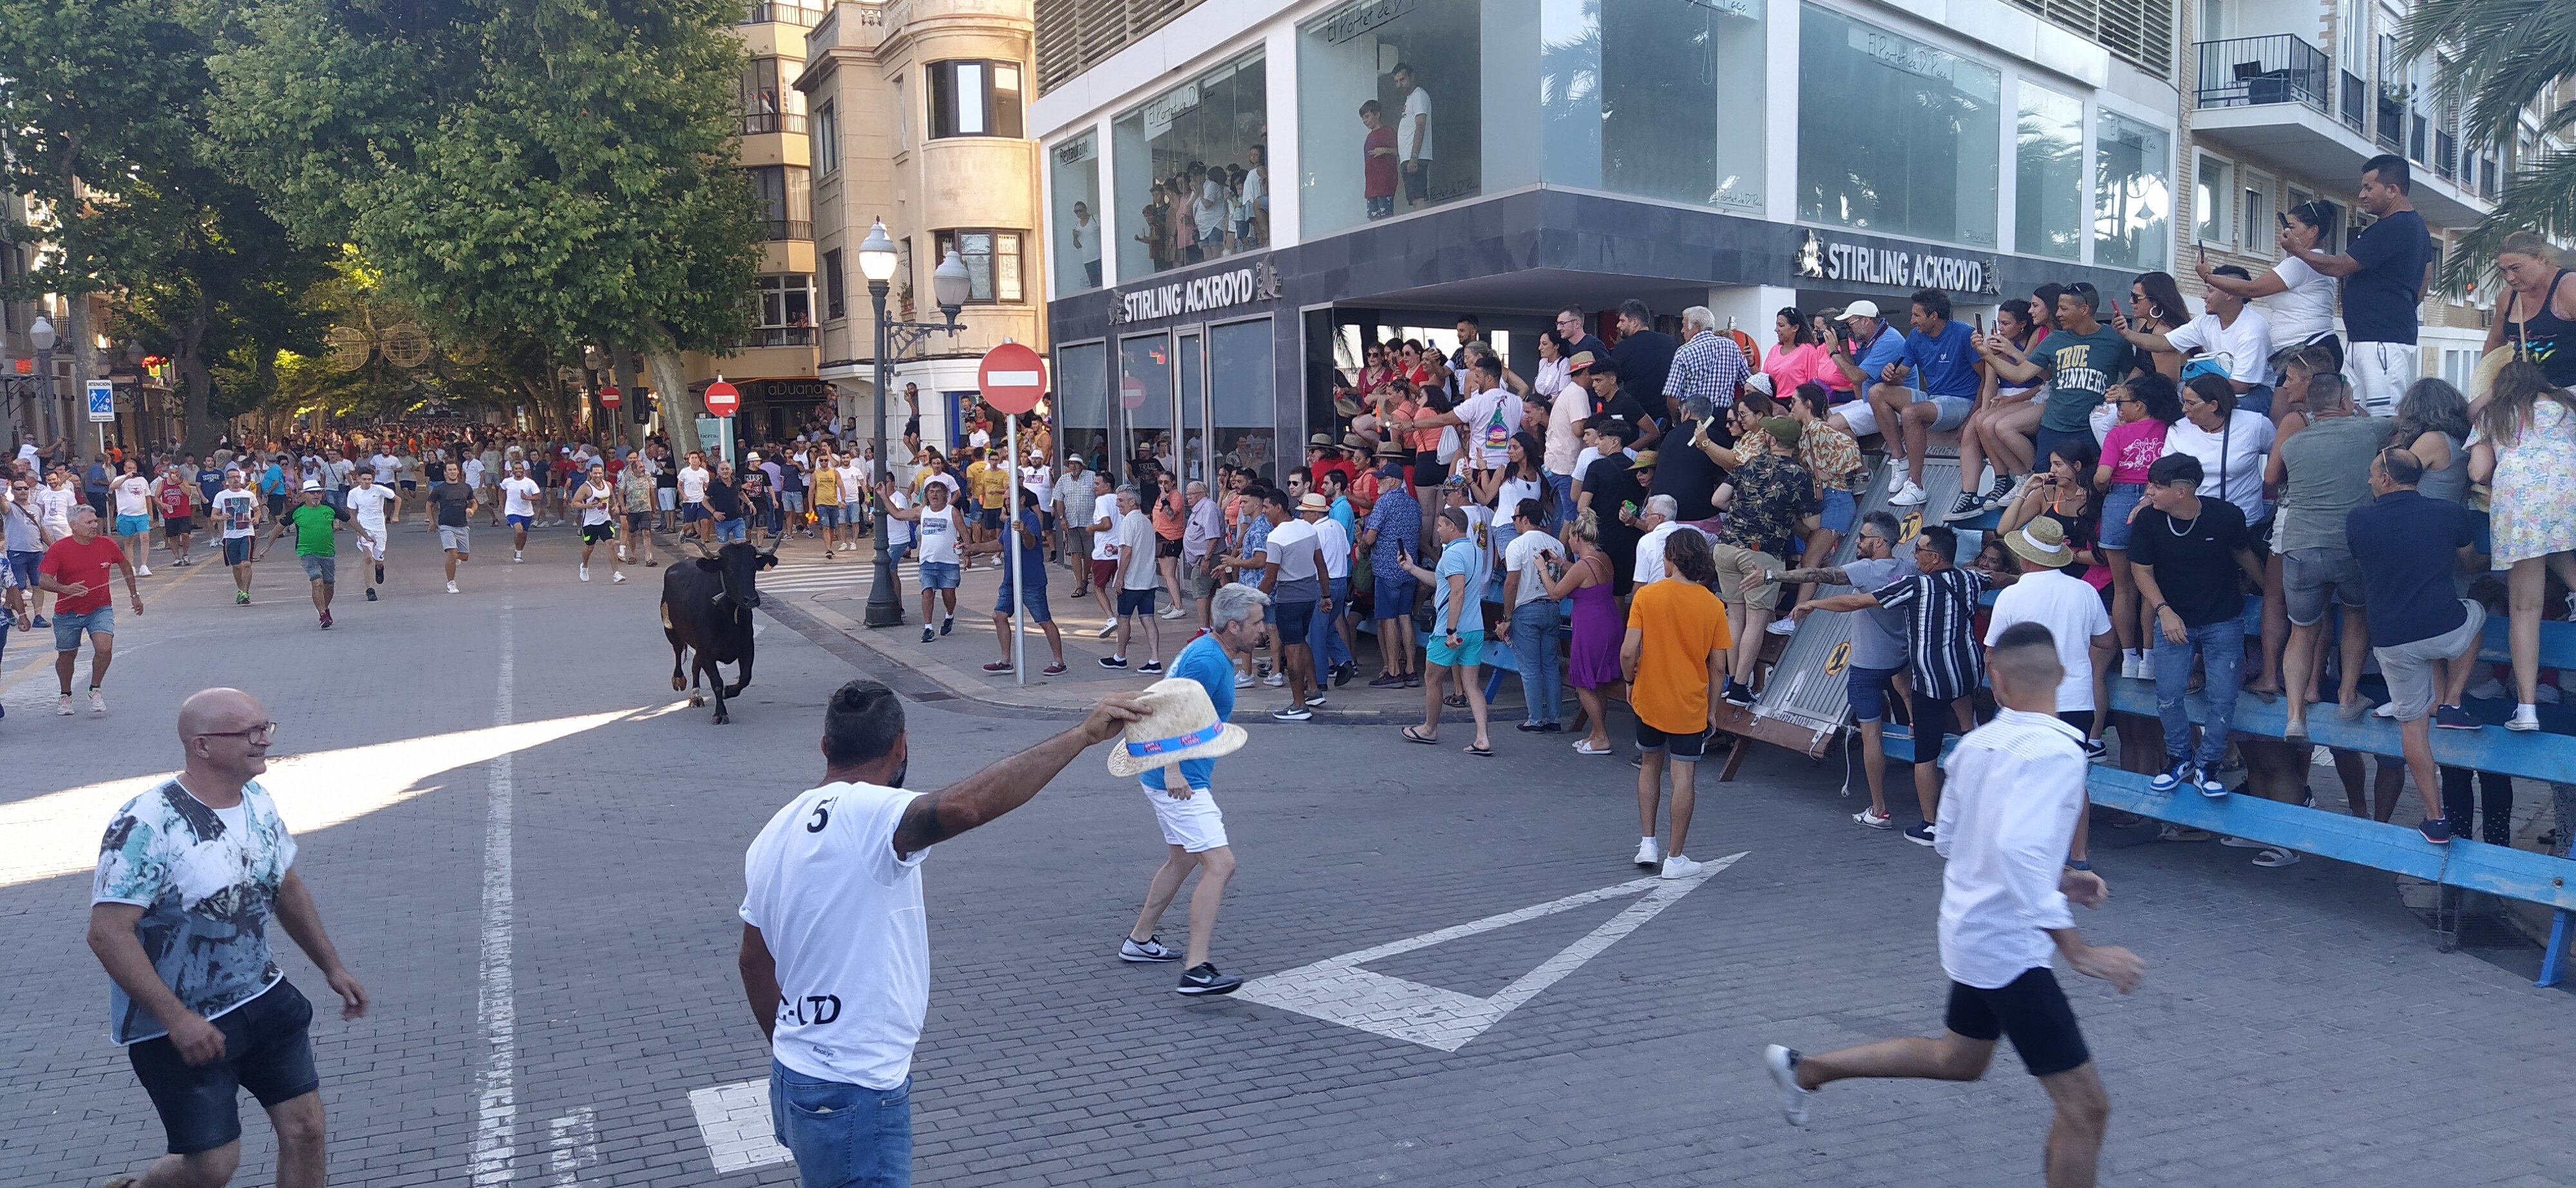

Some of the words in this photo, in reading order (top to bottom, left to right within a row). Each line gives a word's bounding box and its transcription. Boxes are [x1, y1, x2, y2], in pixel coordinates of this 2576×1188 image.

[1327, 14, 1336, 43] El
[1340, 0, 1373, 39] Portet
[1059, 138, 1088, 164] Restaurant
[1828, 243, 1909, 287] STIRLING
[1912, 253, 1982, 293] ACKROYD
[1124, 283, 1182, 323] STIRLING
[1184, 269, 1253, 314] ACKROYD
[2056, 344, 2090, 371] TRUE
[768, 381, 823, 396] aDuana
[2056, 367, 2108, 396] WINNERS
[167, 495, 181, 506] 23
[806, 796, 835, 834] 5
[812, 1045, 835, 1058] Brooklyn
